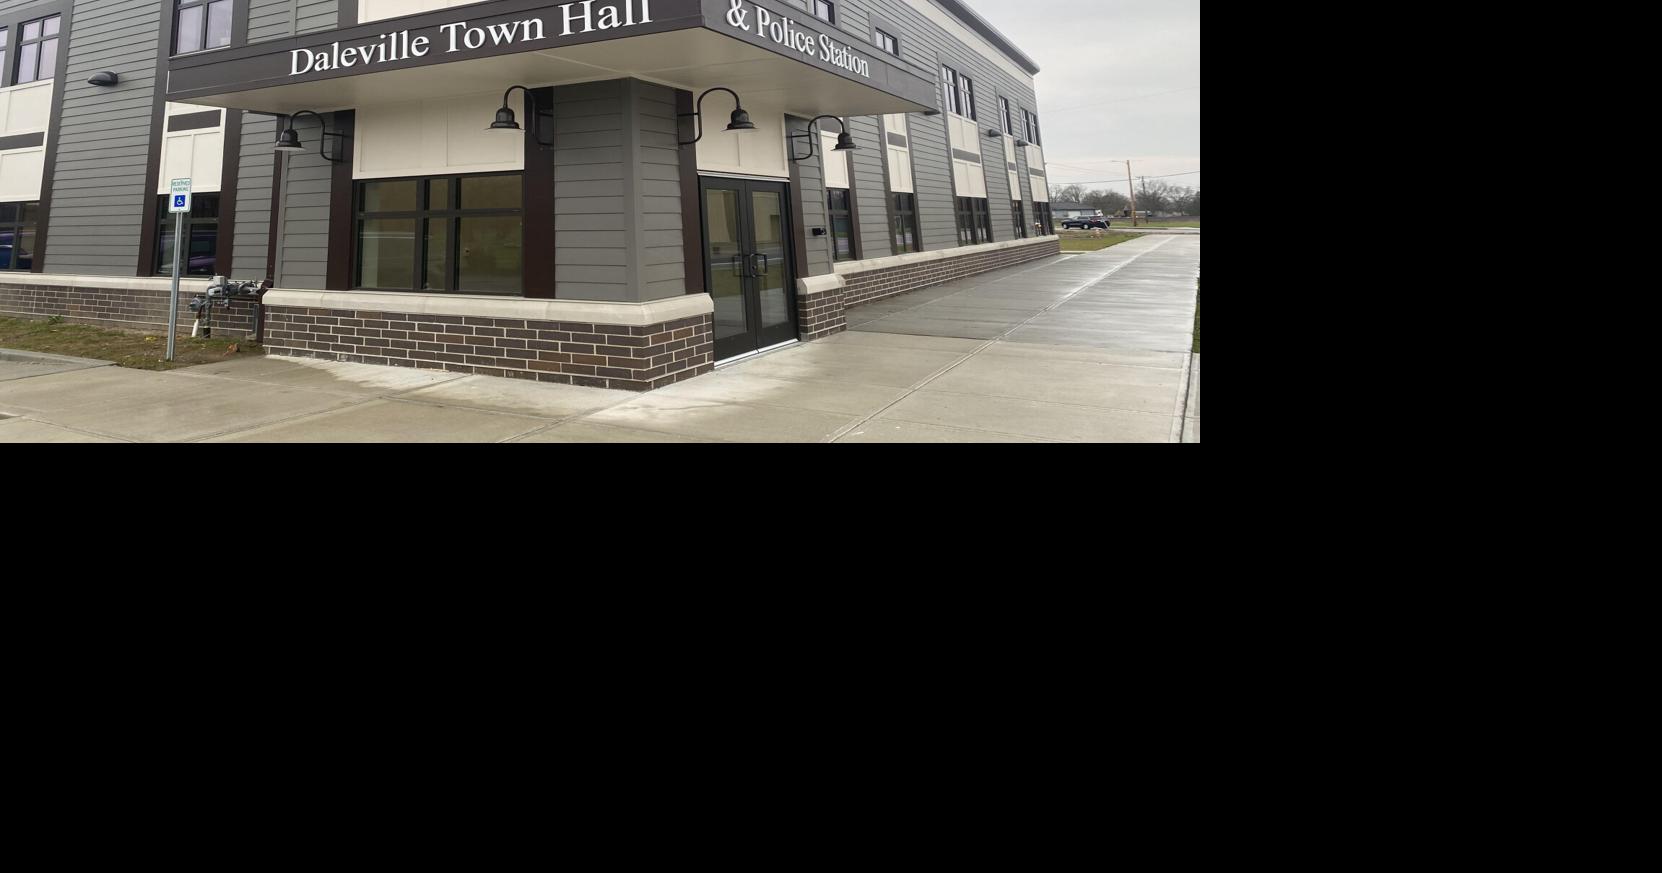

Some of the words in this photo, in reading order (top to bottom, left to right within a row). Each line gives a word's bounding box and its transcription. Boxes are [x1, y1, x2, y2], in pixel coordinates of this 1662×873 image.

[288, 29, 430, 76] Daleville
[439, 16, 546, 53] Town
[557, 0, 653, 37] Hall
[726, 0, 750, 31] &
[755, 5, 815, 56] Police
[818, 33, 870, 78] Station
